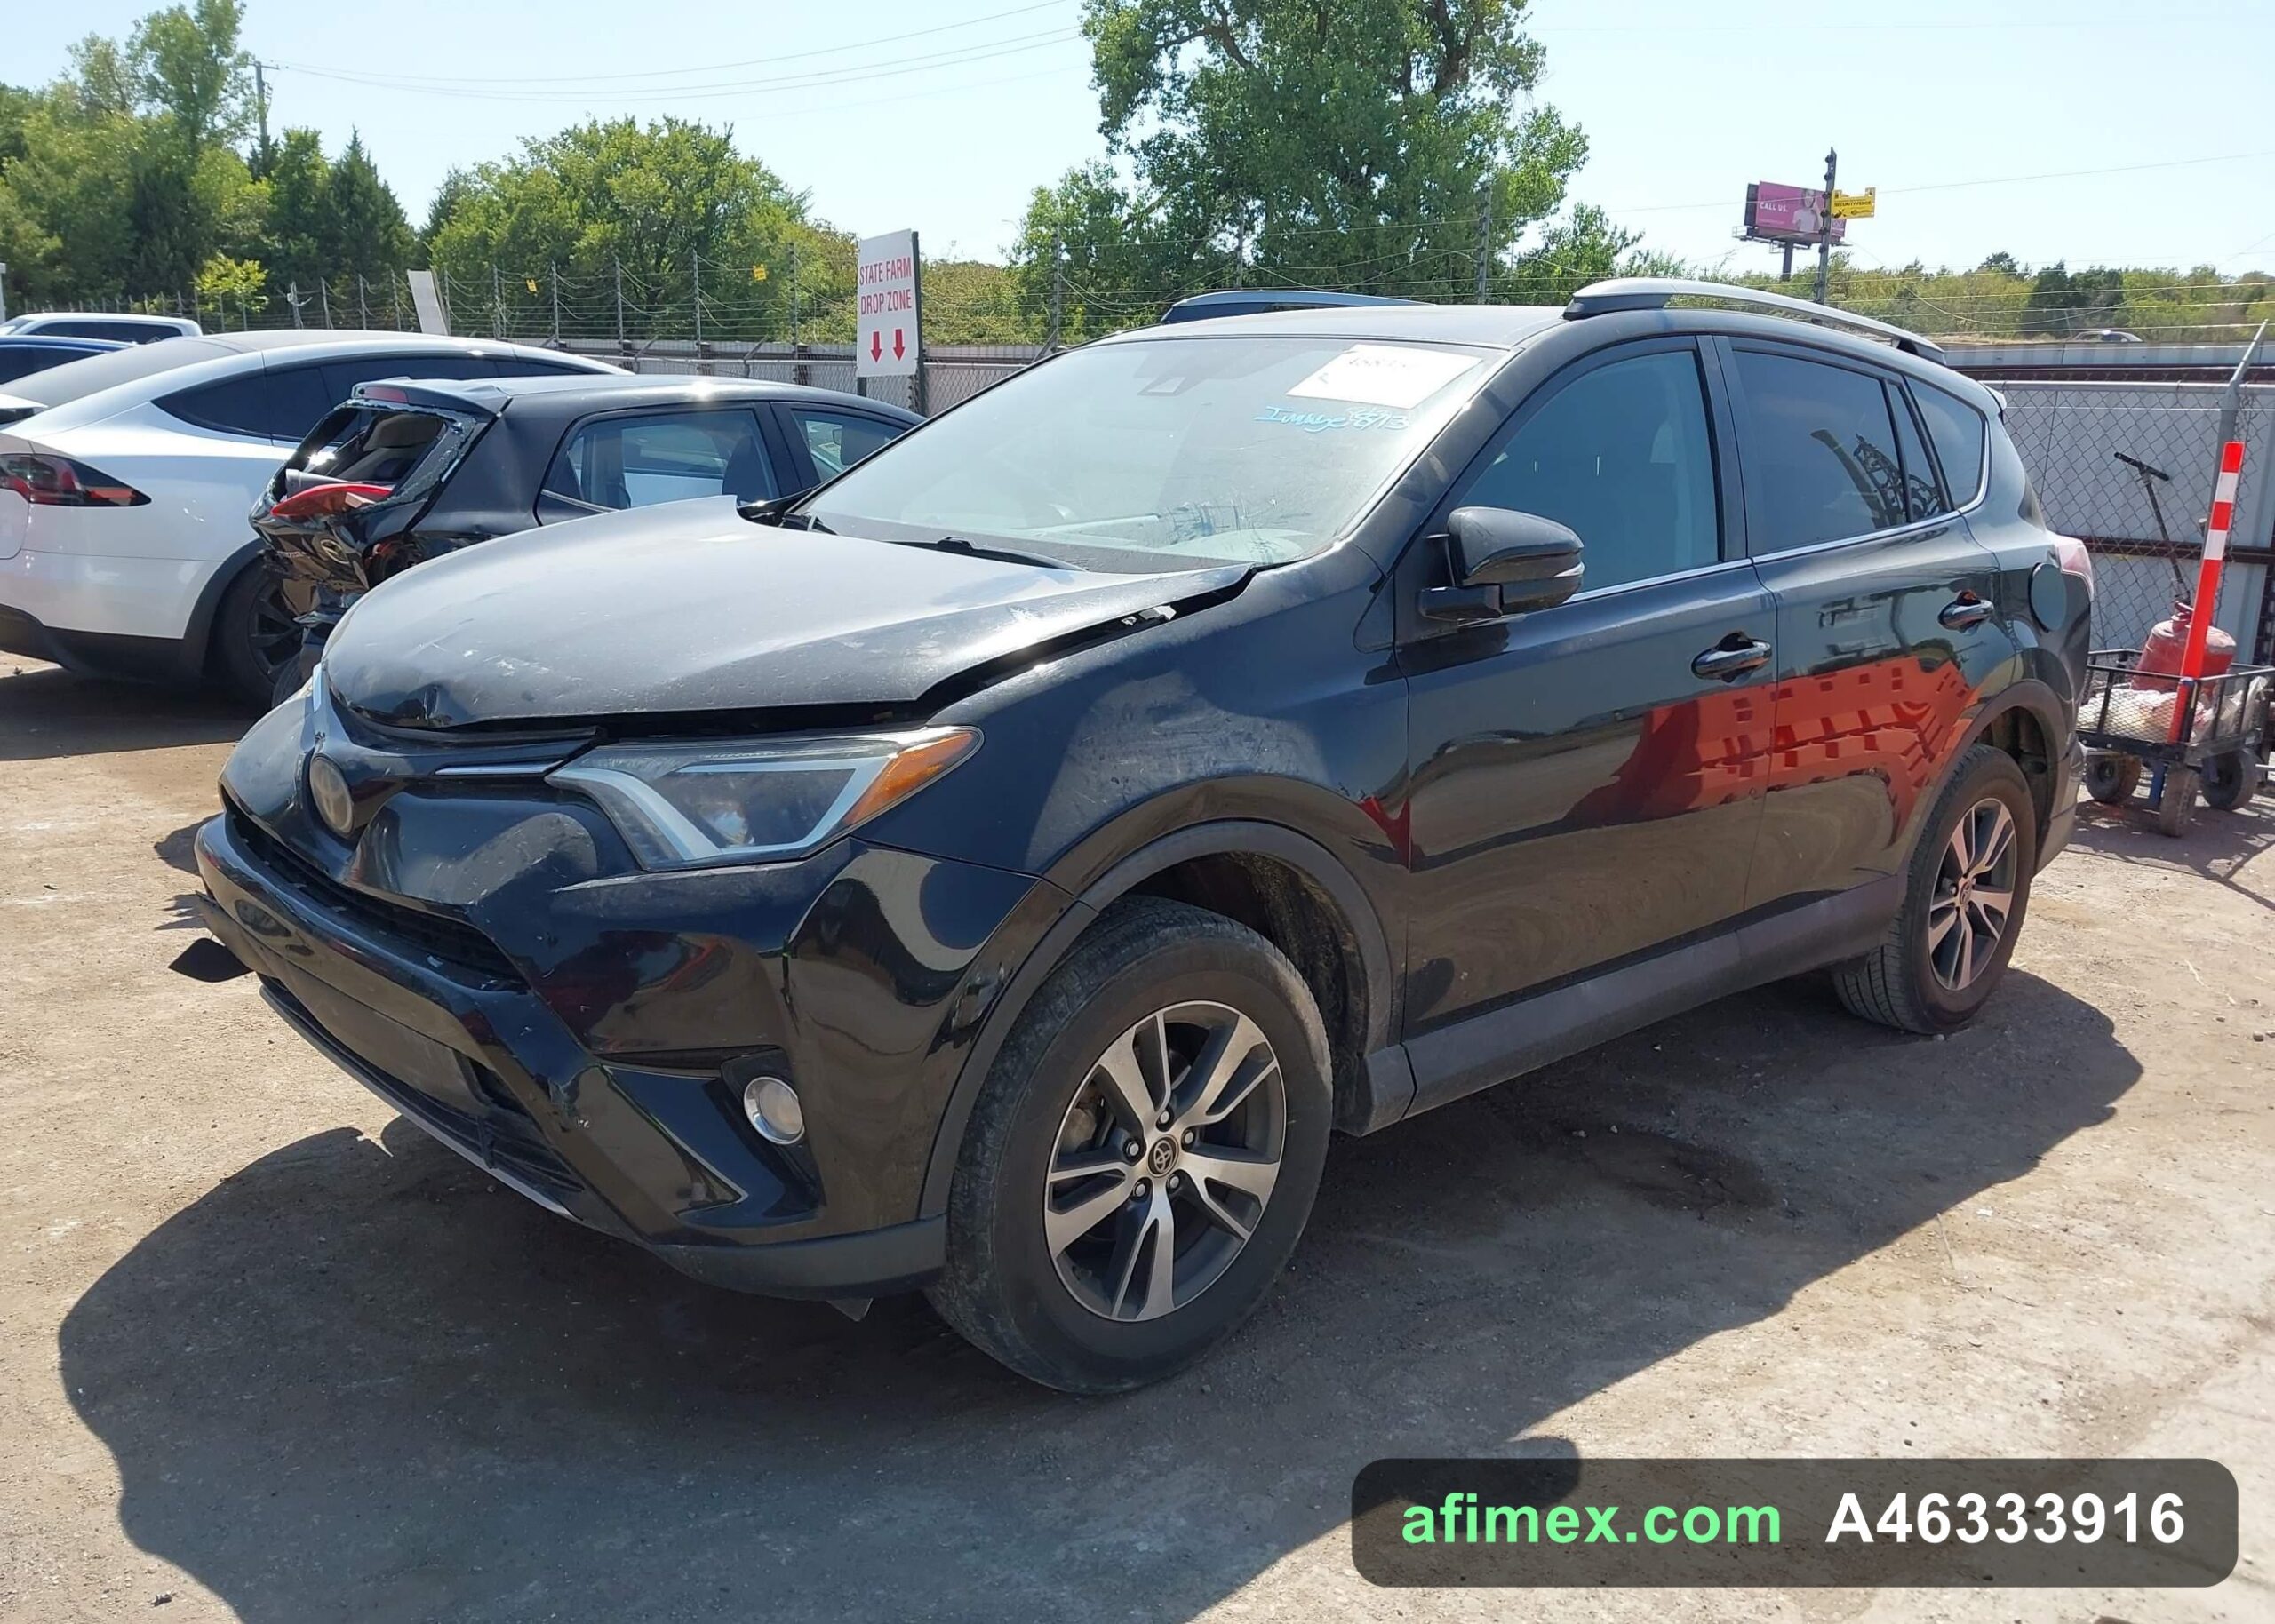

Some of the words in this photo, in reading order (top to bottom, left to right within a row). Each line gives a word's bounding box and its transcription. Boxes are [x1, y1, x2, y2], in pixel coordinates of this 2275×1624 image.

[1760, 202, 1776, 211] CALL
[859, 262, 883, 286] STATE
[886, 257, 912, 280] FARM
[860, 292, 884, 314] DROP
[887, 289, 912, 311] ZONE
